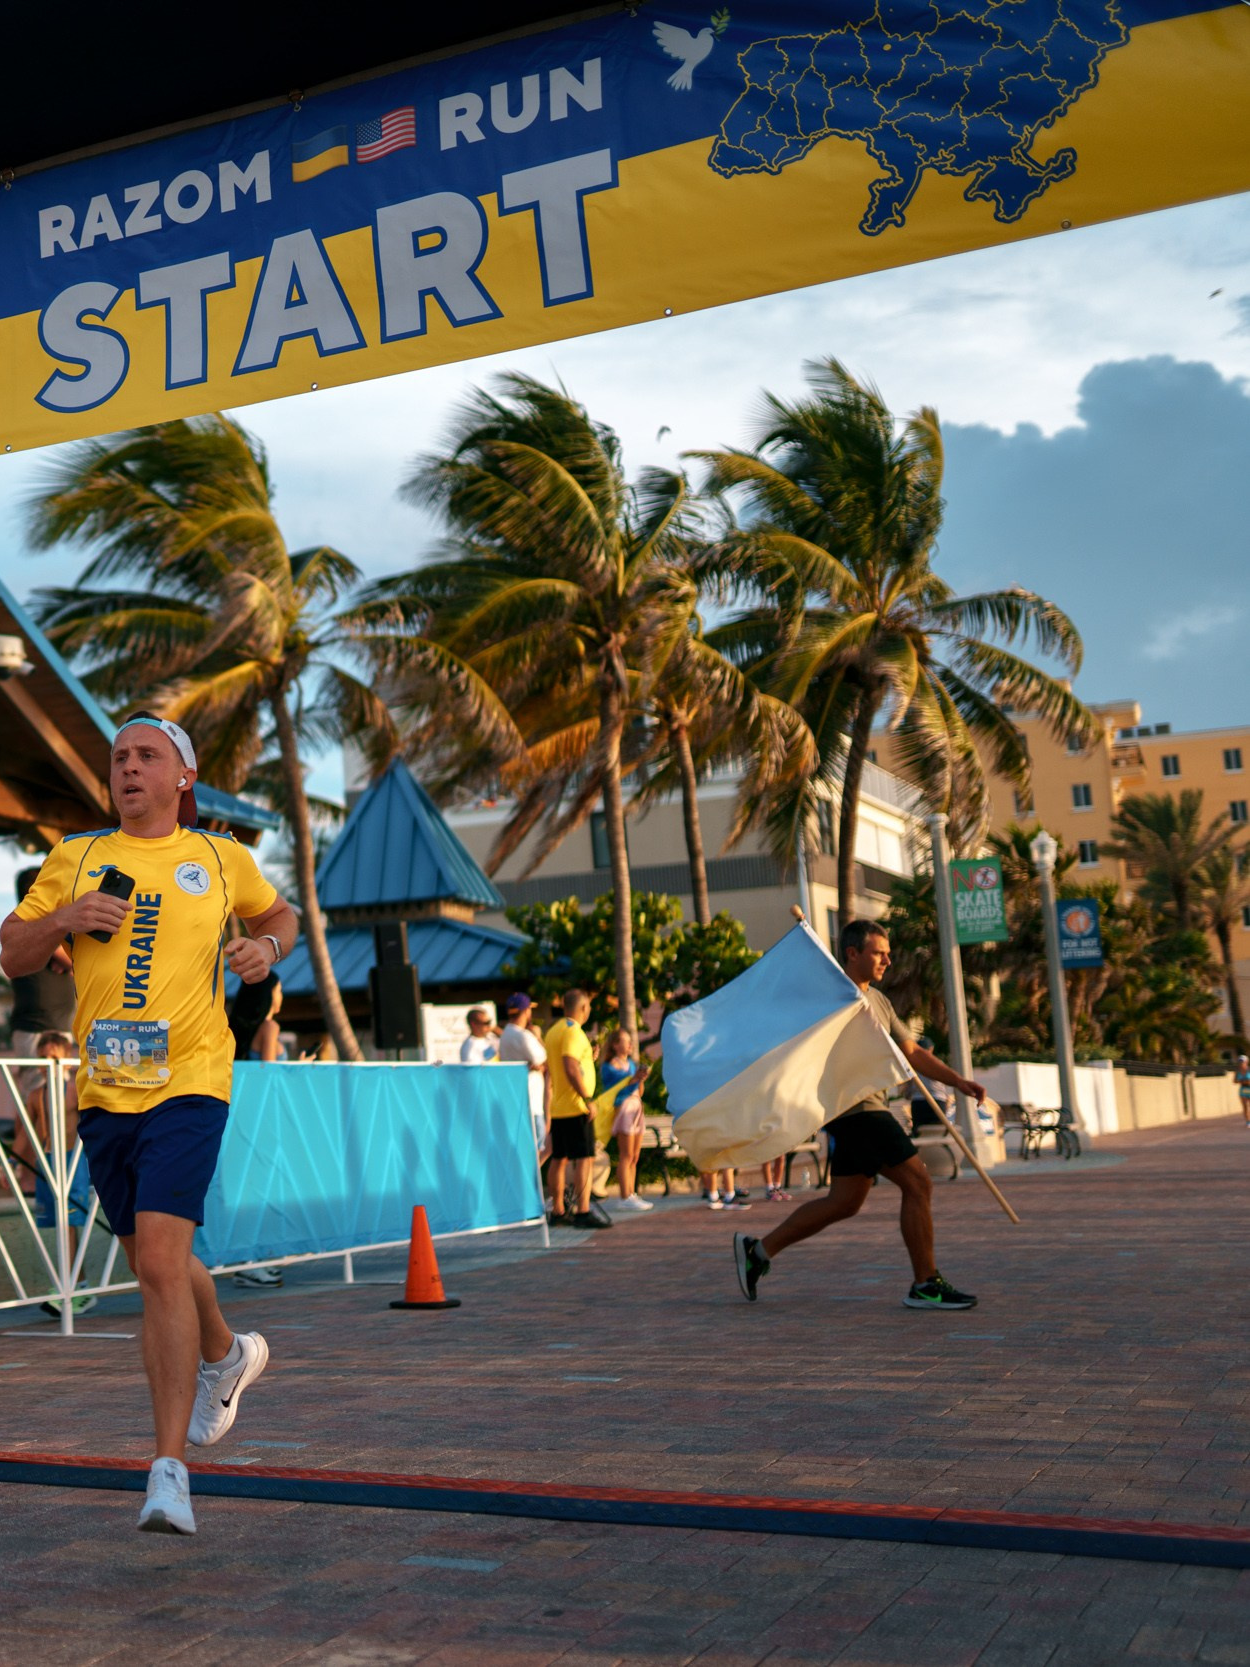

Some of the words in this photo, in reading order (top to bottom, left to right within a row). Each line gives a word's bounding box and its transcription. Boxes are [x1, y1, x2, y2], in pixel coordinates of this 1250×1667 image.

[38, 151, 272, 258] RAZOM
[438, 57, 603, 151] RUN
[34, 148, 619, 414] START
[955, 889, 1002, 908] SKATE
[956, 906, 1003, 920] BOARDS
[122, 893, 162, 1010] UKRAINE
[138, 1025, 159, 1033] RUN
[105, 1037, 141, 1067] 38
